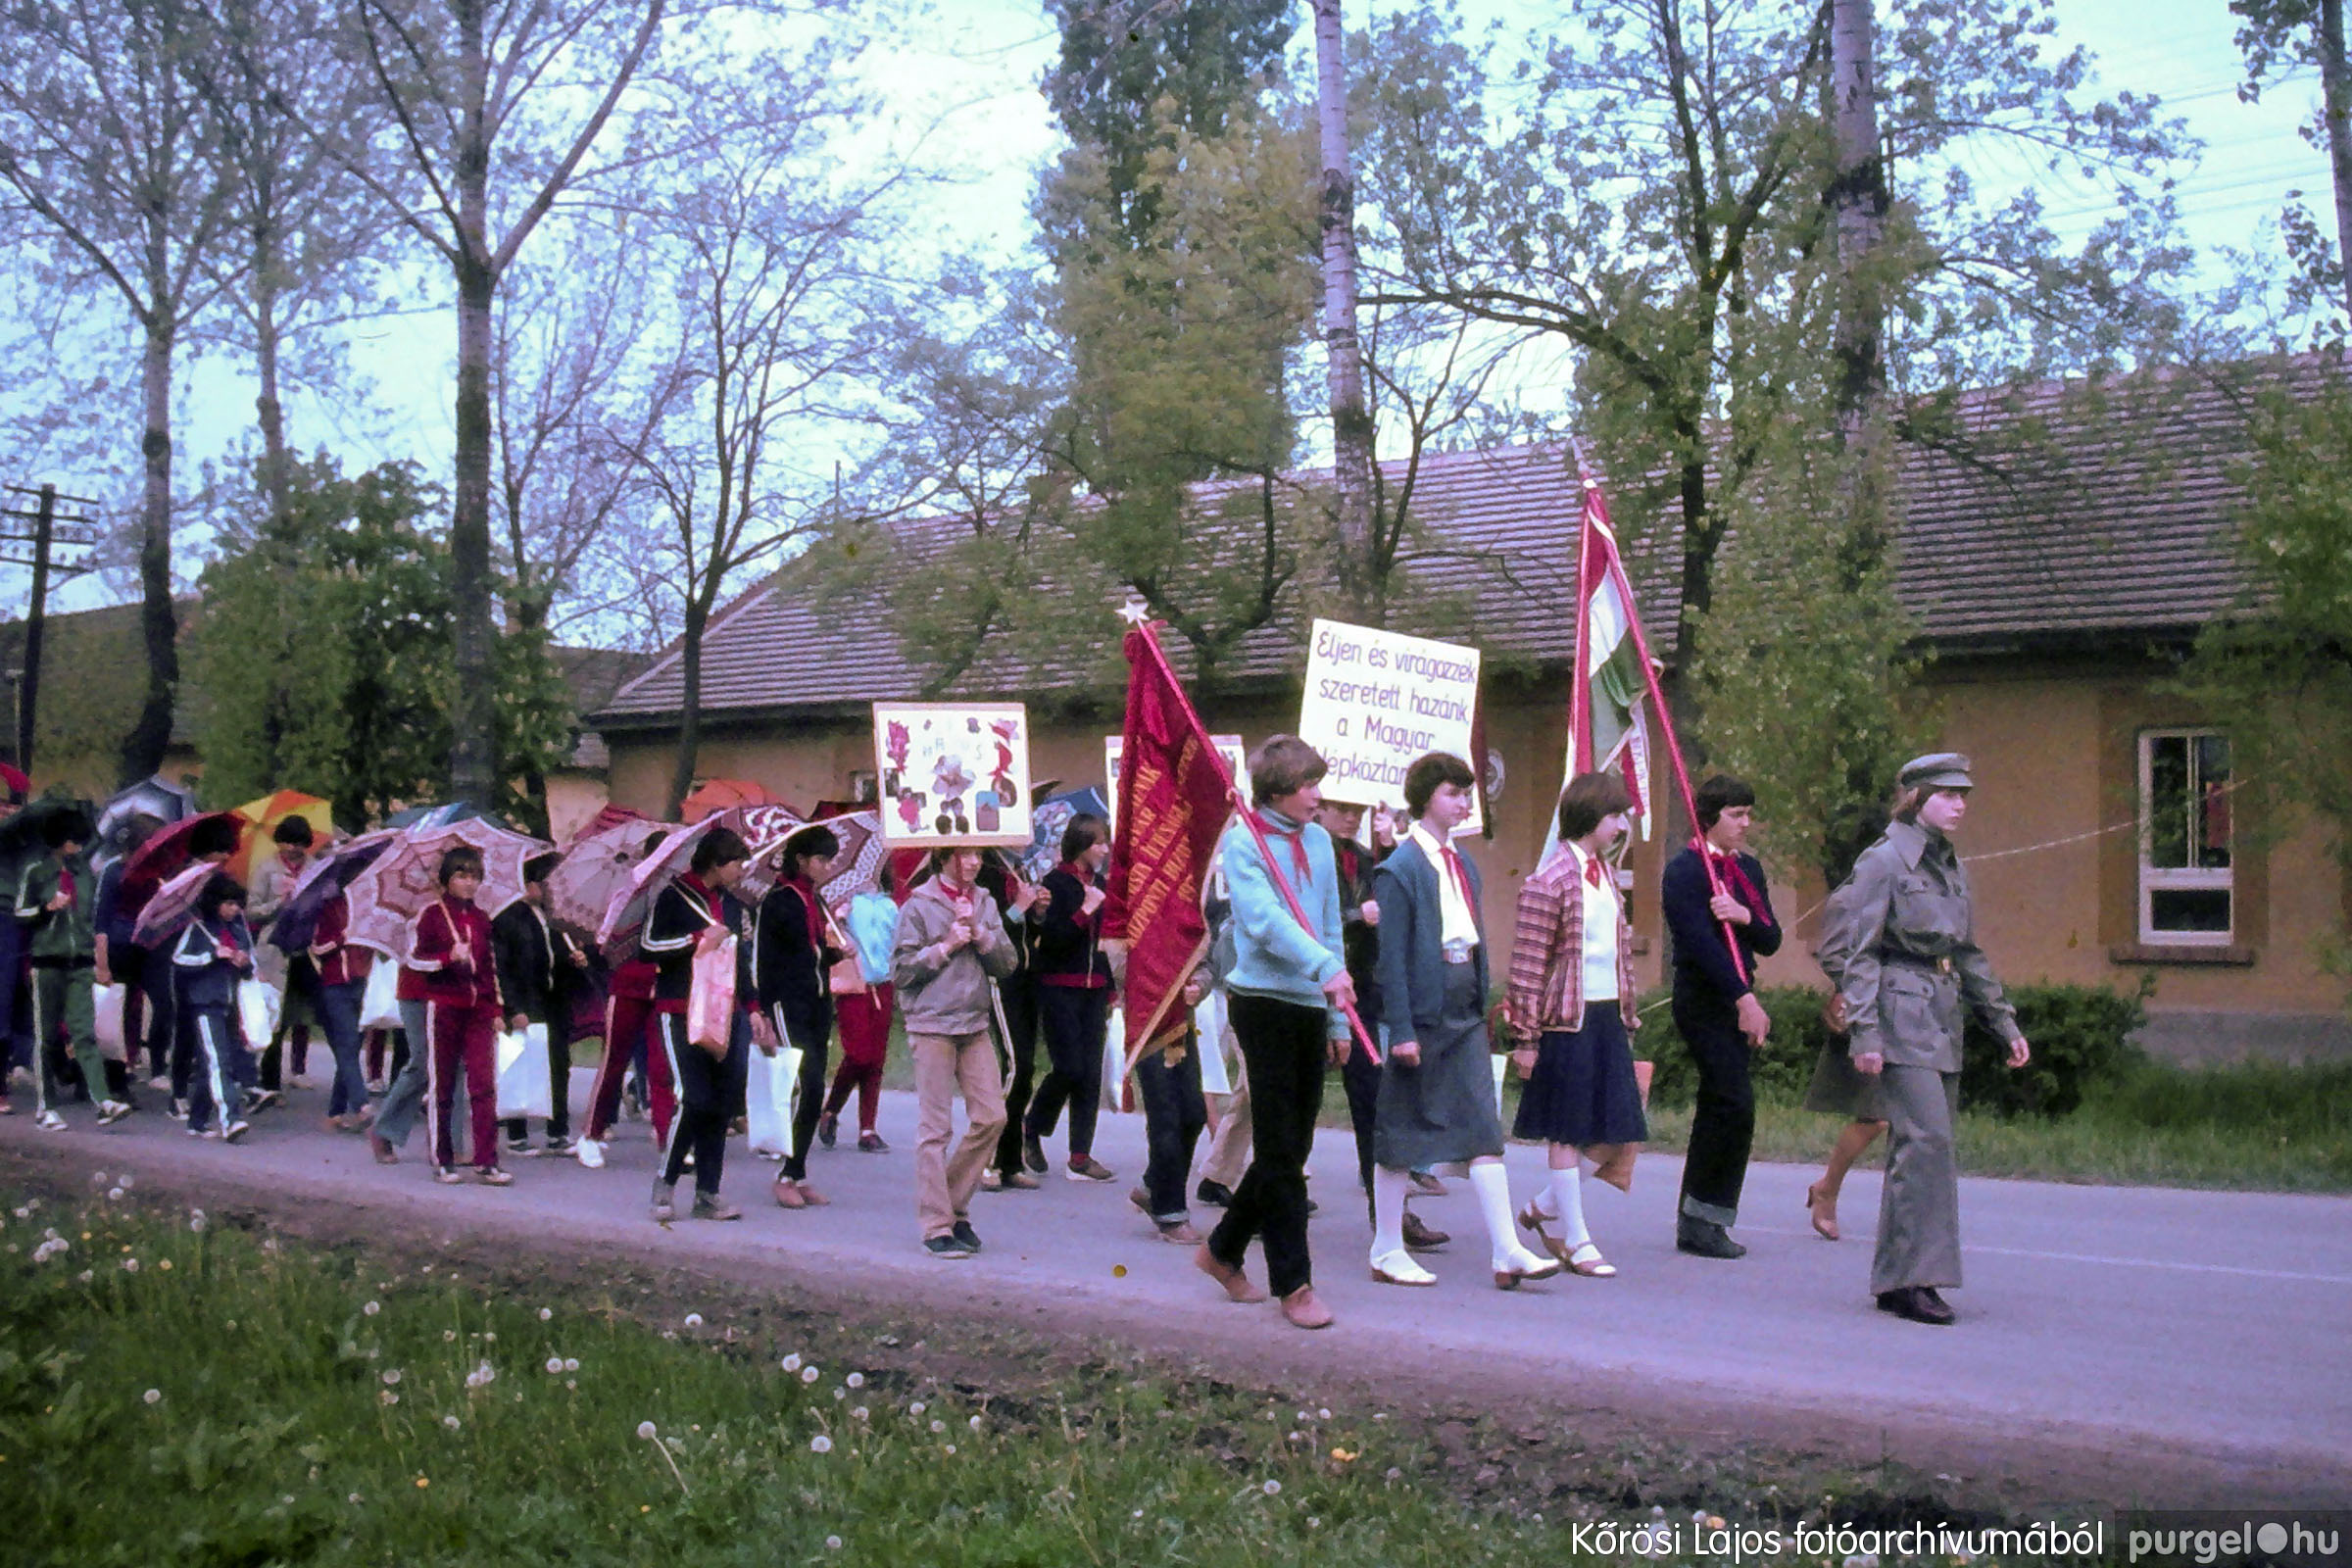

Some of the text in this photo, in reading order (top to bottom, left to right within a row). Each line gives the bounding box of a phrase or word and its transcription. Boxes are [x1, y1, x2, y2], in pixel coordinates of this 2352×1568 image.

[1317, 625, 1362, 666] Éljen
[1368, 638, 1389, 668] és
[1319, 678, 1400, 710] szeretett
[1337, 713, 1435, 755] a Magyar
